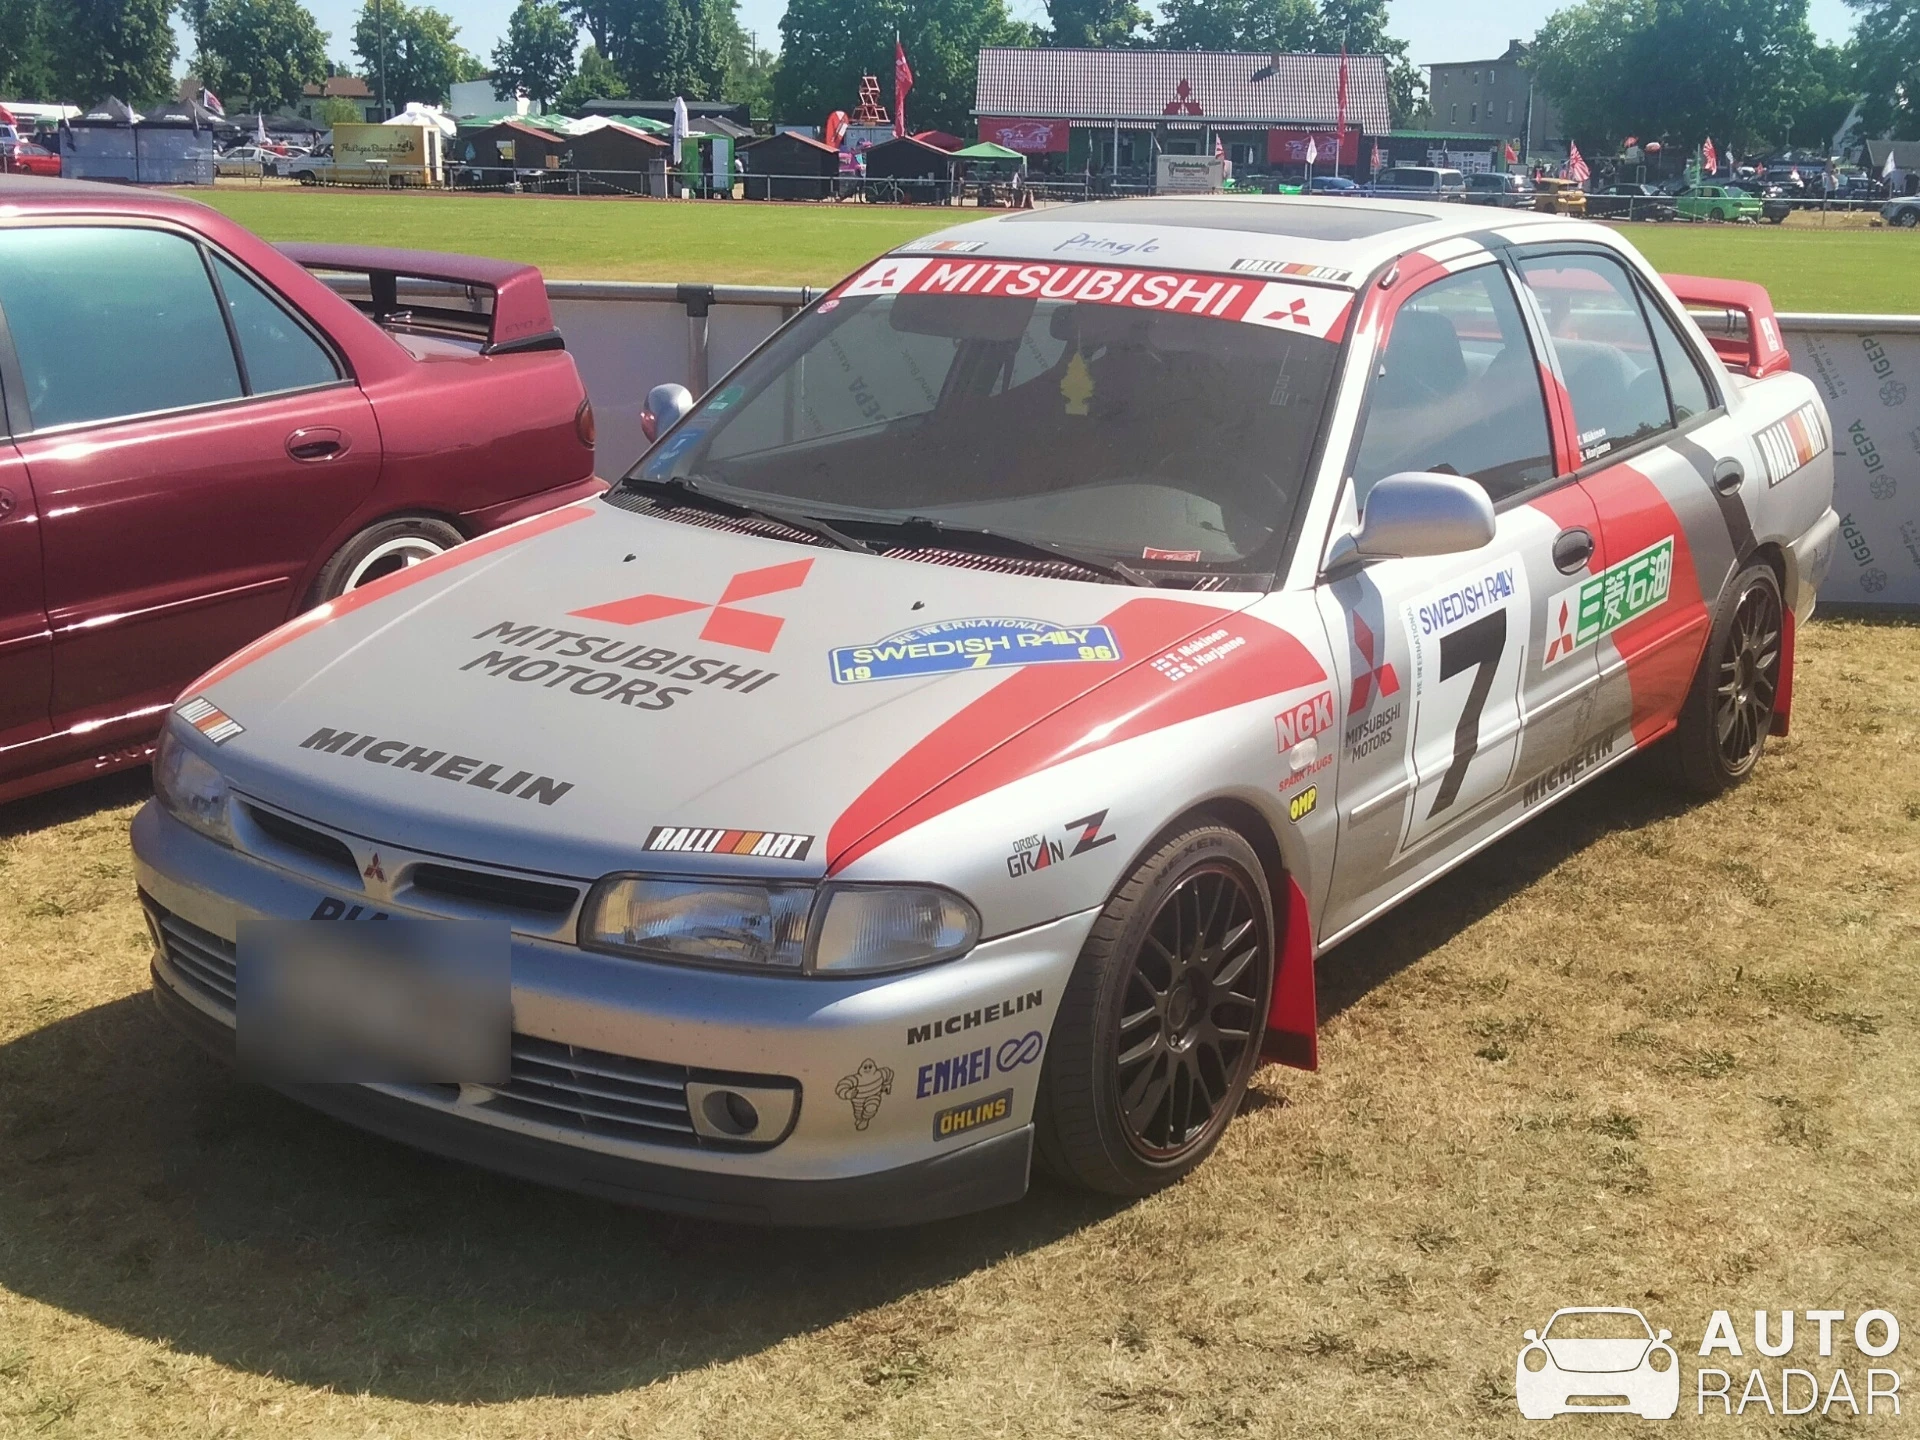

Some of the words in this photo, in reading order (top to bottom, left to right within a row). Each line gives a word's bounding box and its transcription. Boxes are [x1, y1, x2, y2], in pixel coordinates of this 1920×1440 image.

[1053, 232, 1159, 256] Pringle
[918, 261, 1243, 316] MITSUBISHI
[1848, 419, 1884, 474] IGEPA
[1840, 513, 1874, 567] IGEPA
[1420, 581, 1486, 635] SWEDISH
[1578, 546, 1671, 640] 三菱石油
[472, 620, 780, 695] MITSUBISHI
[842, 666, 871, 681] 19
[964, 654, 992, 668] 7
[1078, 646, 1111, 660] 96
[853, 635, 1011, 664] SWEDISH
[459, 650, 693, 712] MOTORS
[1276, 692, 1334, 752] NGK
[1345, 702, 1401, 748] MITSUBISHI
[1427, 607, 1507, 820] 7
[298, 728, 574, 806] MICHELIN
[1352, 726, 1392, 763] MOTORS
[1522, 733, 1615, 808] MICHELIN
[1279, 767, 1305, 791] SPARK
[1306, 754, 1333, 776] PLUGS
[1291, 788, 1316, 819] OMP
[650, 828, 725, 853] RALLI
[749, 833, 809, 858] ART
[1012, 834, 1041, 853] ORBIS
[1064, 808, 1117, 857] Z
[907, 989, 1043, 1045] MICHELIN
[916, 1047, 991, 1099] ENKEI
[940, 1097, 1007, 1136] ÖHLINS
